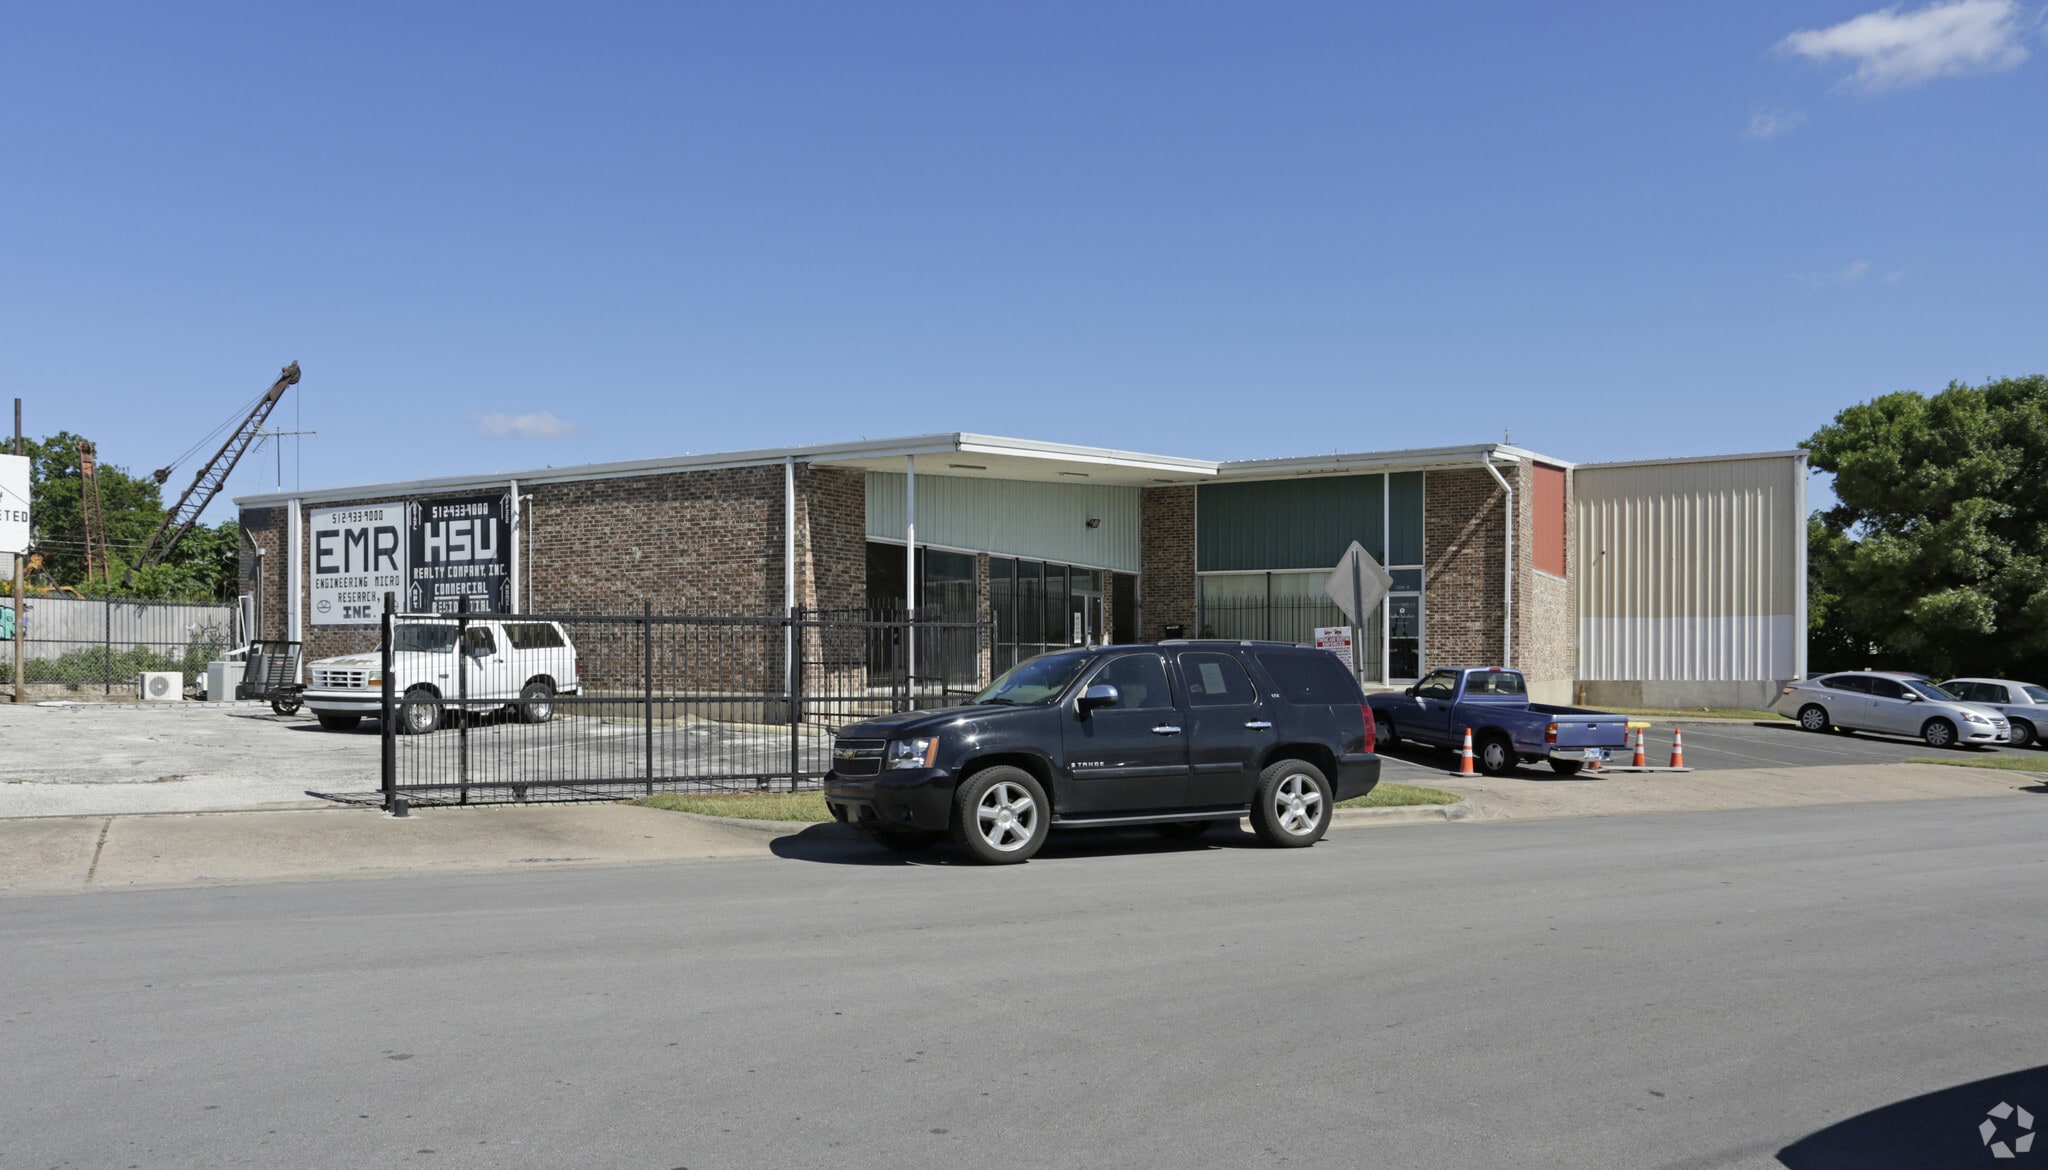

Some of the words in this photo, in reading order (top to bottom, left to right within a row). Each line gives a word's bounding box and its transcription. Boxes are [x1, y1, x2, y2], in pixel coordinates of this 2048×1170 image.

[424, 518, 497, 562] HSU
[316, 525, 399, 574] EMR
[413, 566, 445, 580] REALTY
[447, 564, 487, 578] COMPANY,
[488, 563, 508, 576] INC.
[316, 576, 368, 589] ENGINEERING
[375, 575, 400, 587] MICRO
[434, 581, 488, 595] COMMERCIAL
[338, 591, 381, 604] RESEARCH,
[343, 605, 377, 619] INC.
